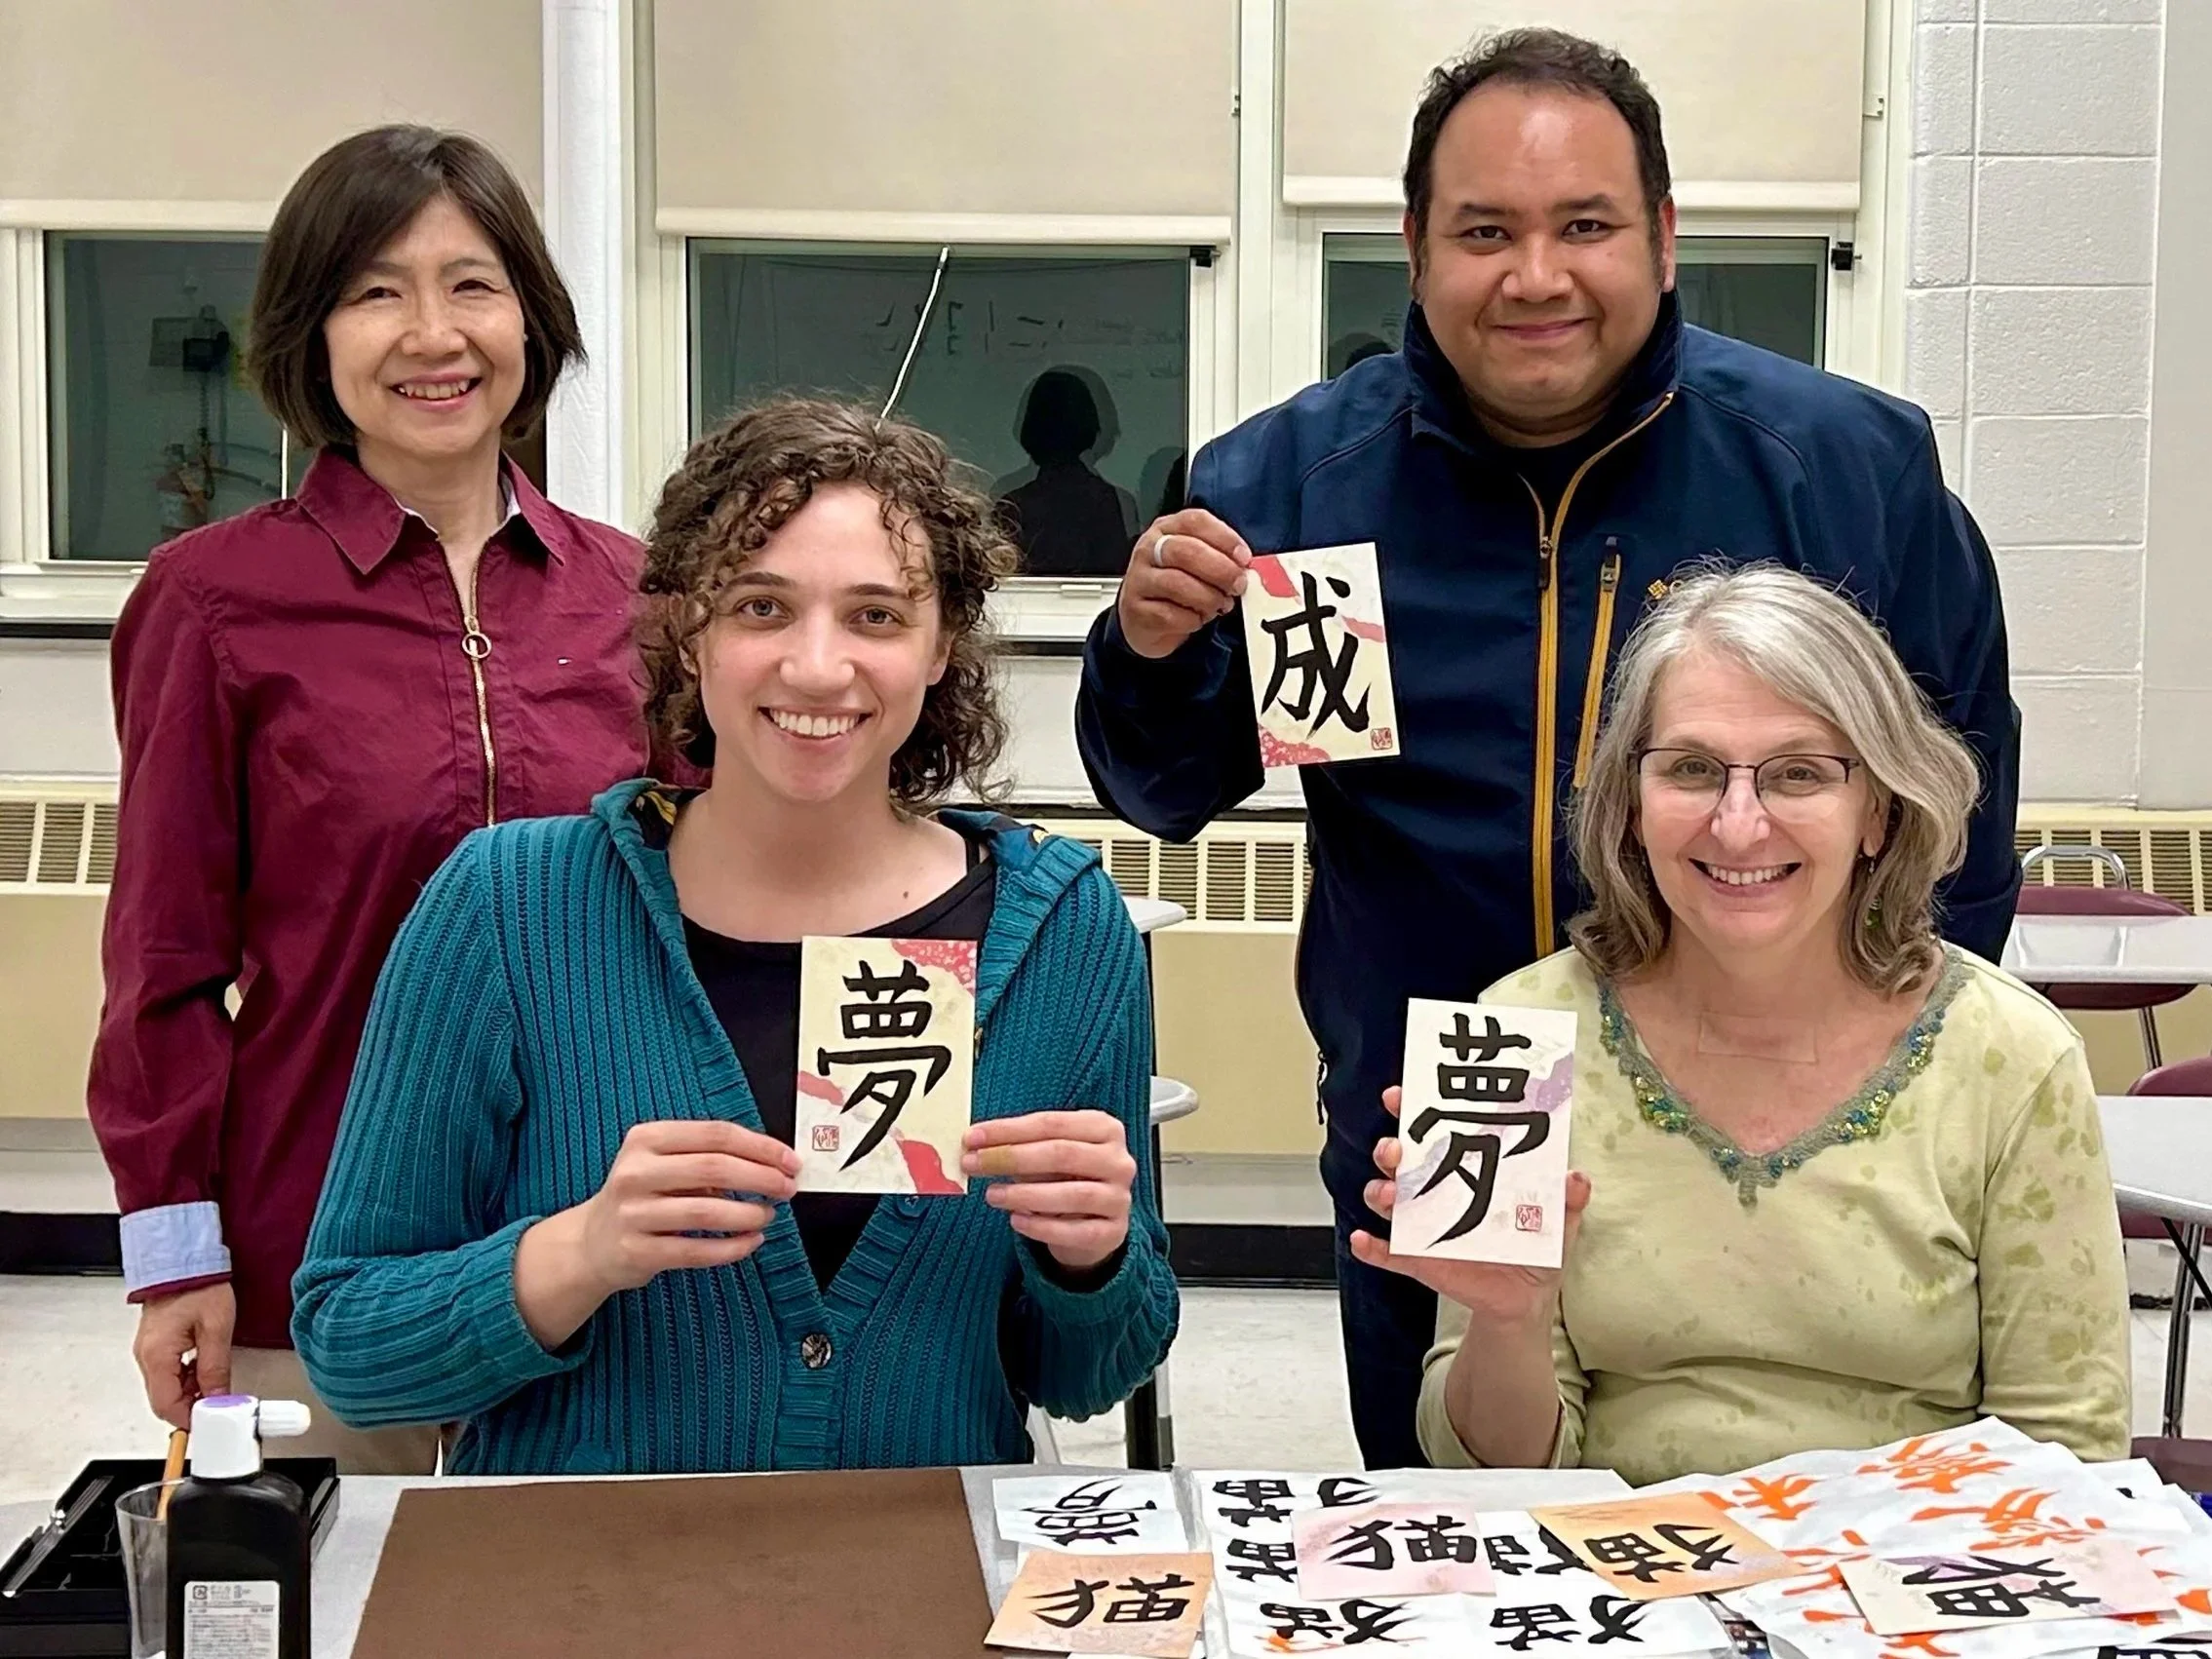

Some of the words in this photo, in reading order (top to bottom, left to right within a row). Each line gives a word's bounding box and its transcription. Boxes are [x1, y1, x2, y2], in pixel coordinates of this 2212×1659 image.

[1261, 571, 1372, 741] 成
[817, 959, 952, 1172] 夢
[1408, 1012, 1550, 1250] 夢
[1024, 1573, 1195, 1628] 猫
[1325, 1515, 1477, 1570] 猫
